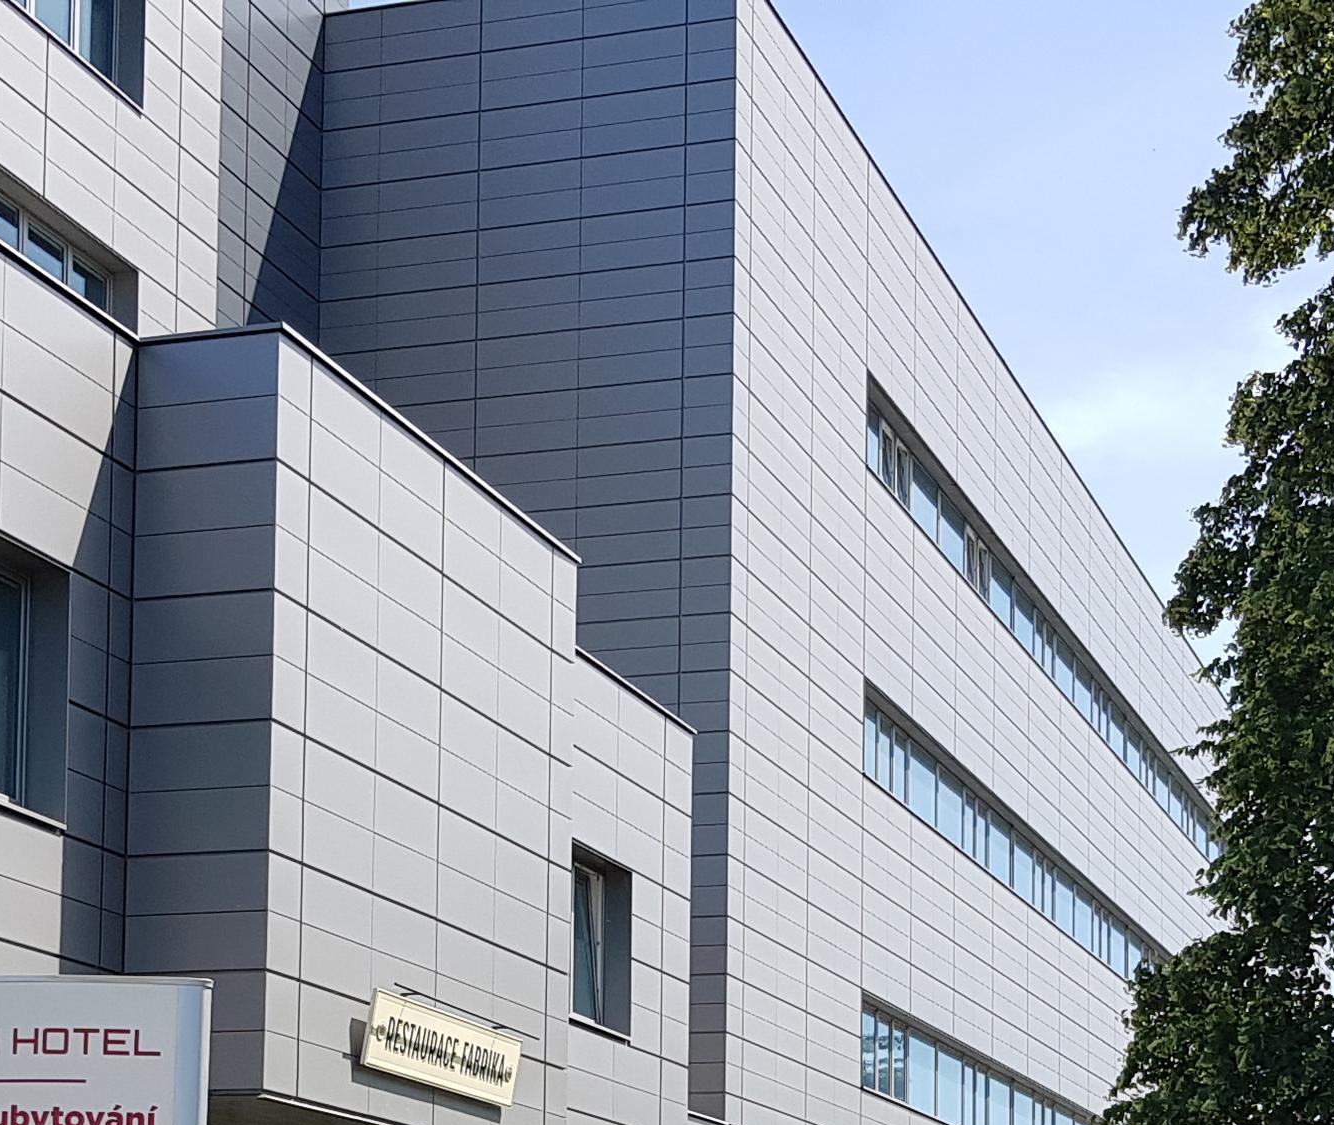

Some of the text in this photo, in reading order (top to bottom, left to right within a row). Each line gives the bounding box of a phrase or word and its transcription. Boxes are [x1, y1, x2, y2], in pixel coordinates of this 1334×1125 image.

[12, 1027, 162, 1056] HOTEL
[384, 1016, 506, 1087] RESTAURACE FABRIKA
